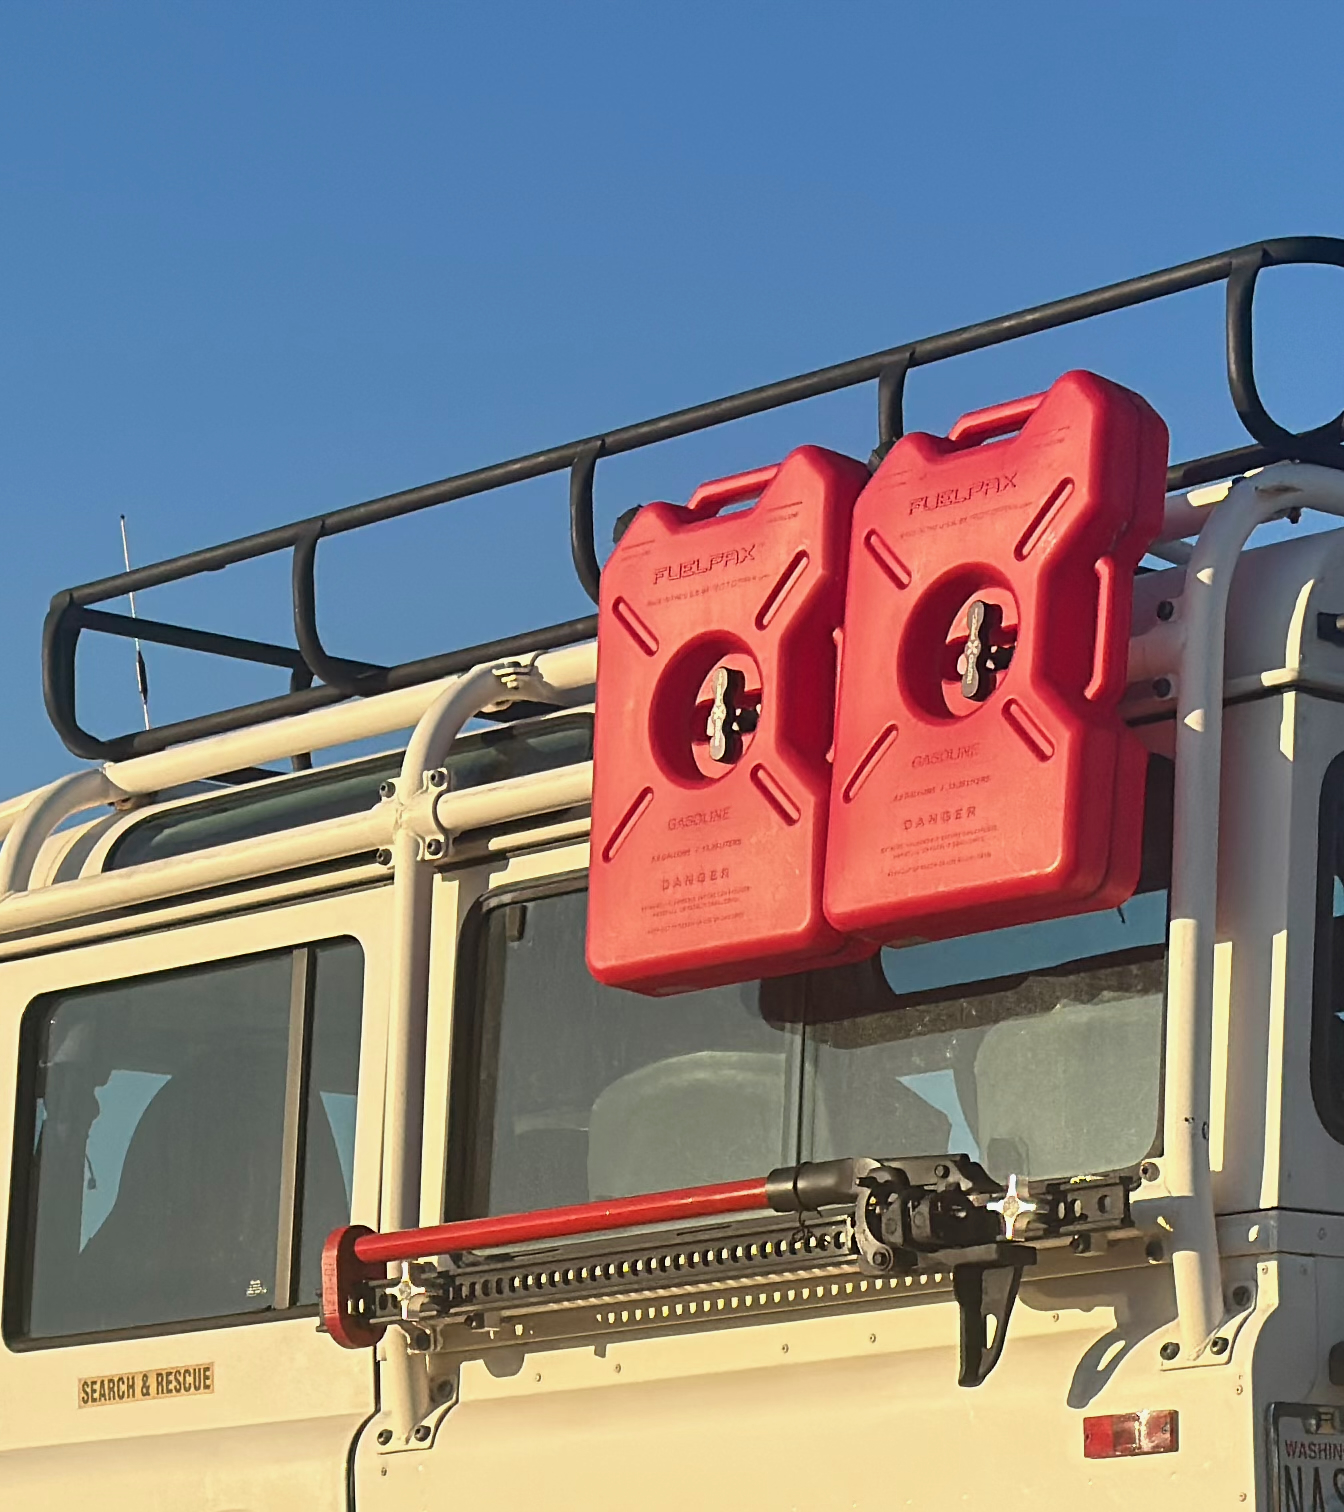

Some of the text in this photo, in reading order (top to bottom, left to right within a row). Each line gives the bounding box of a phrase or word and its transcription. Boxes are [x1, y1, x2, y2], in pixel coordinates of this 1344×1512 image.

[909, 472, 1017, 515] FUELPAX
[653, 543, 755, 585] FUELPAX
[668, 806, 731, 831] GASOLINE
[903, 805, 976, 830] DANGER
[662, 867, 729, 891] DANGER
[82, 1366, 211, 1404] SEARCH & RESCUE
